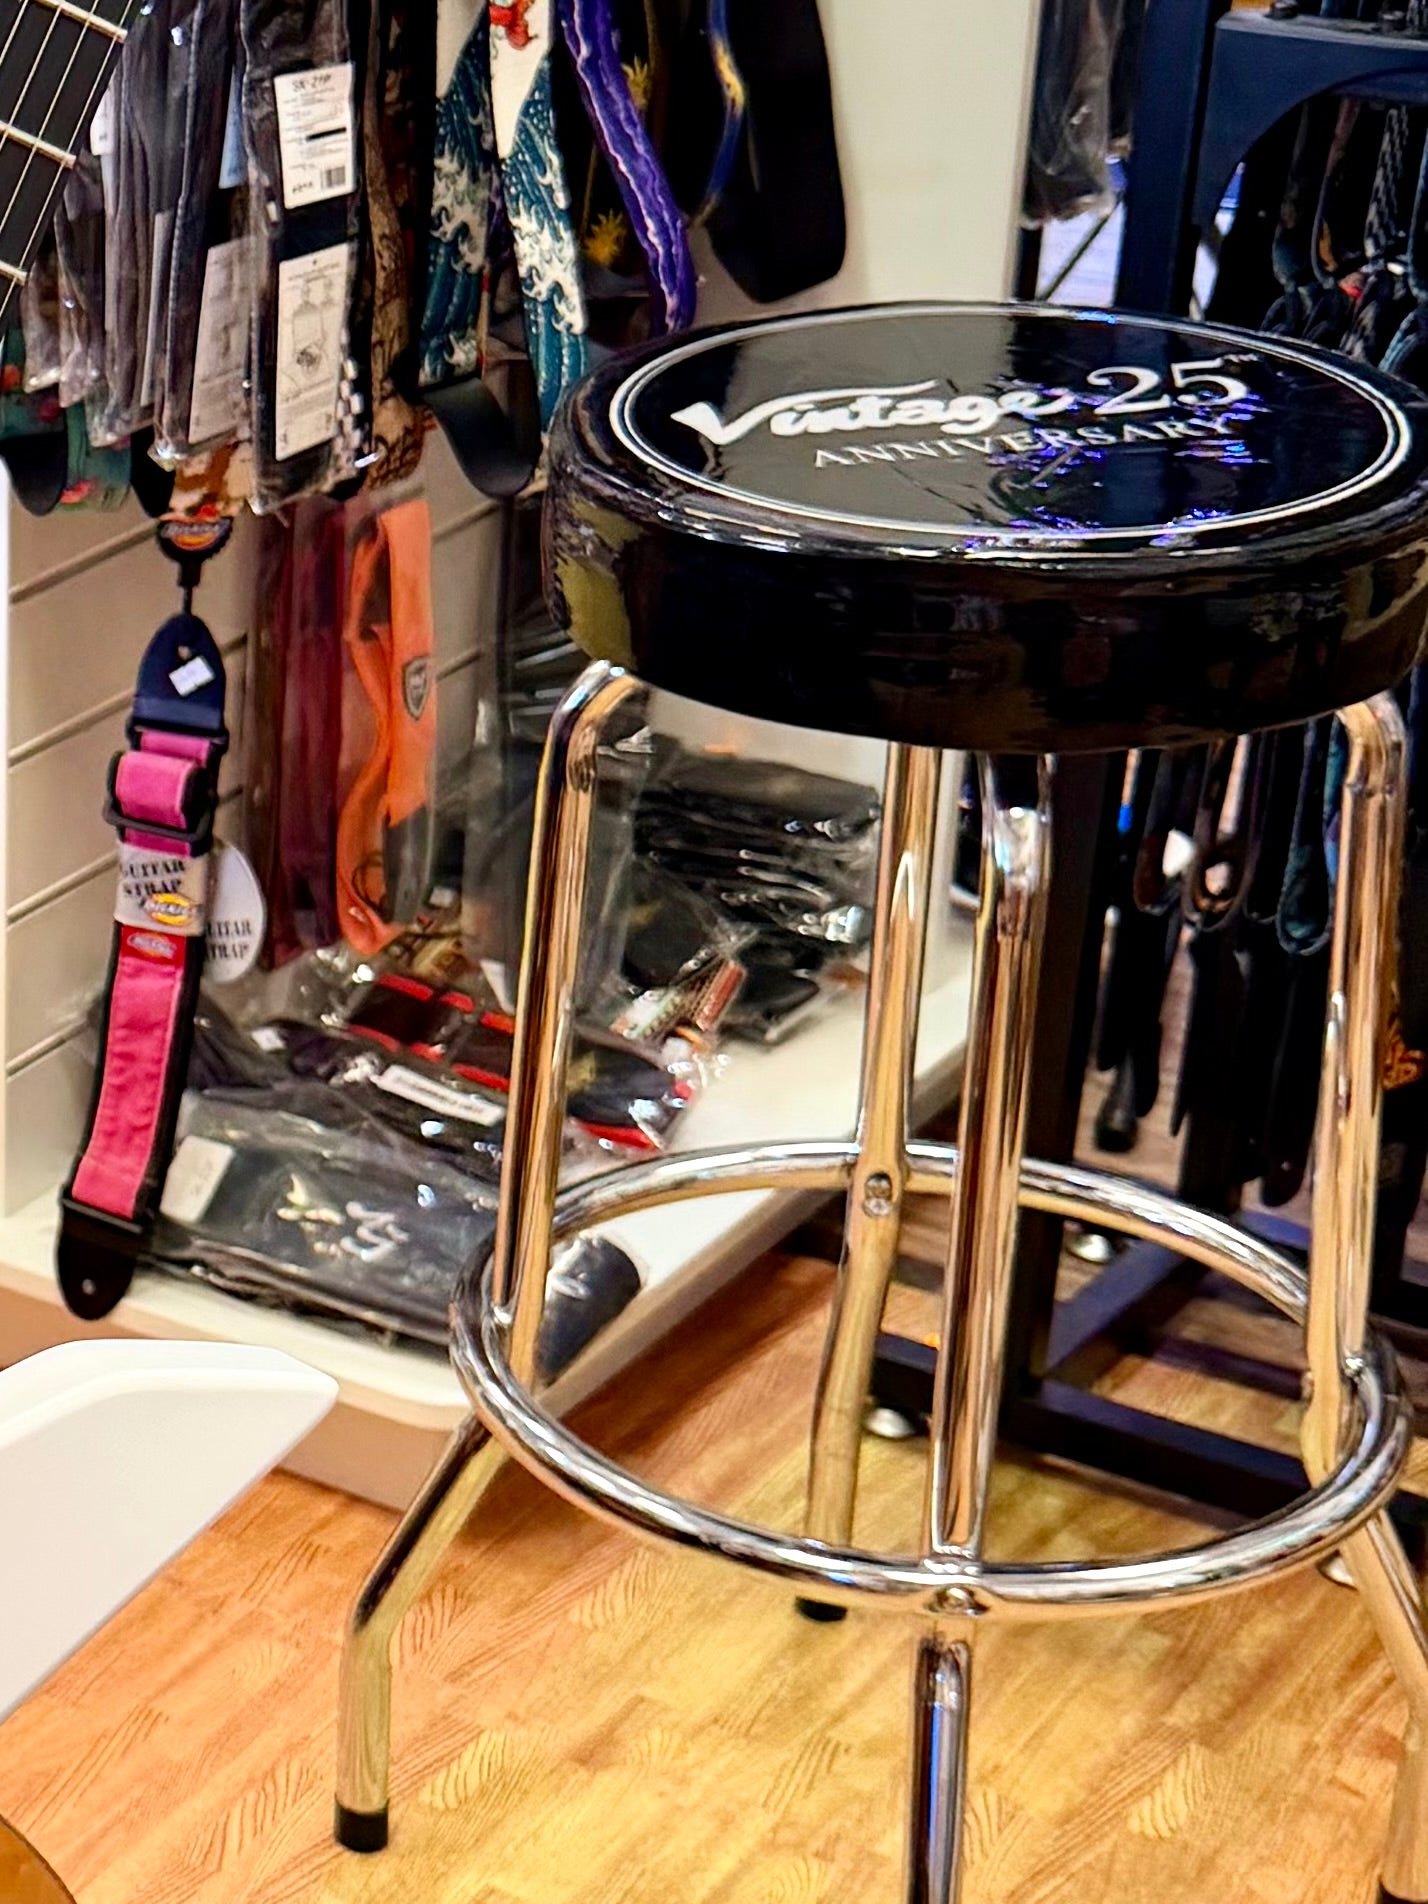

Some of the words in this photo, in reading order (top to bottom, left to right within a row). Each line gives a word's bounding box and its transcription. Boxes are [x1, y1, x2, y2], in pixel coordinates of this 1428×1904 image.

[670, 378, 1080, 445] Vintage
[814, 413, 1244, 469] ANNIVERSARY
[206, 919, 253, 938] UITAR
[208, 943, 250, 962] TRAP
